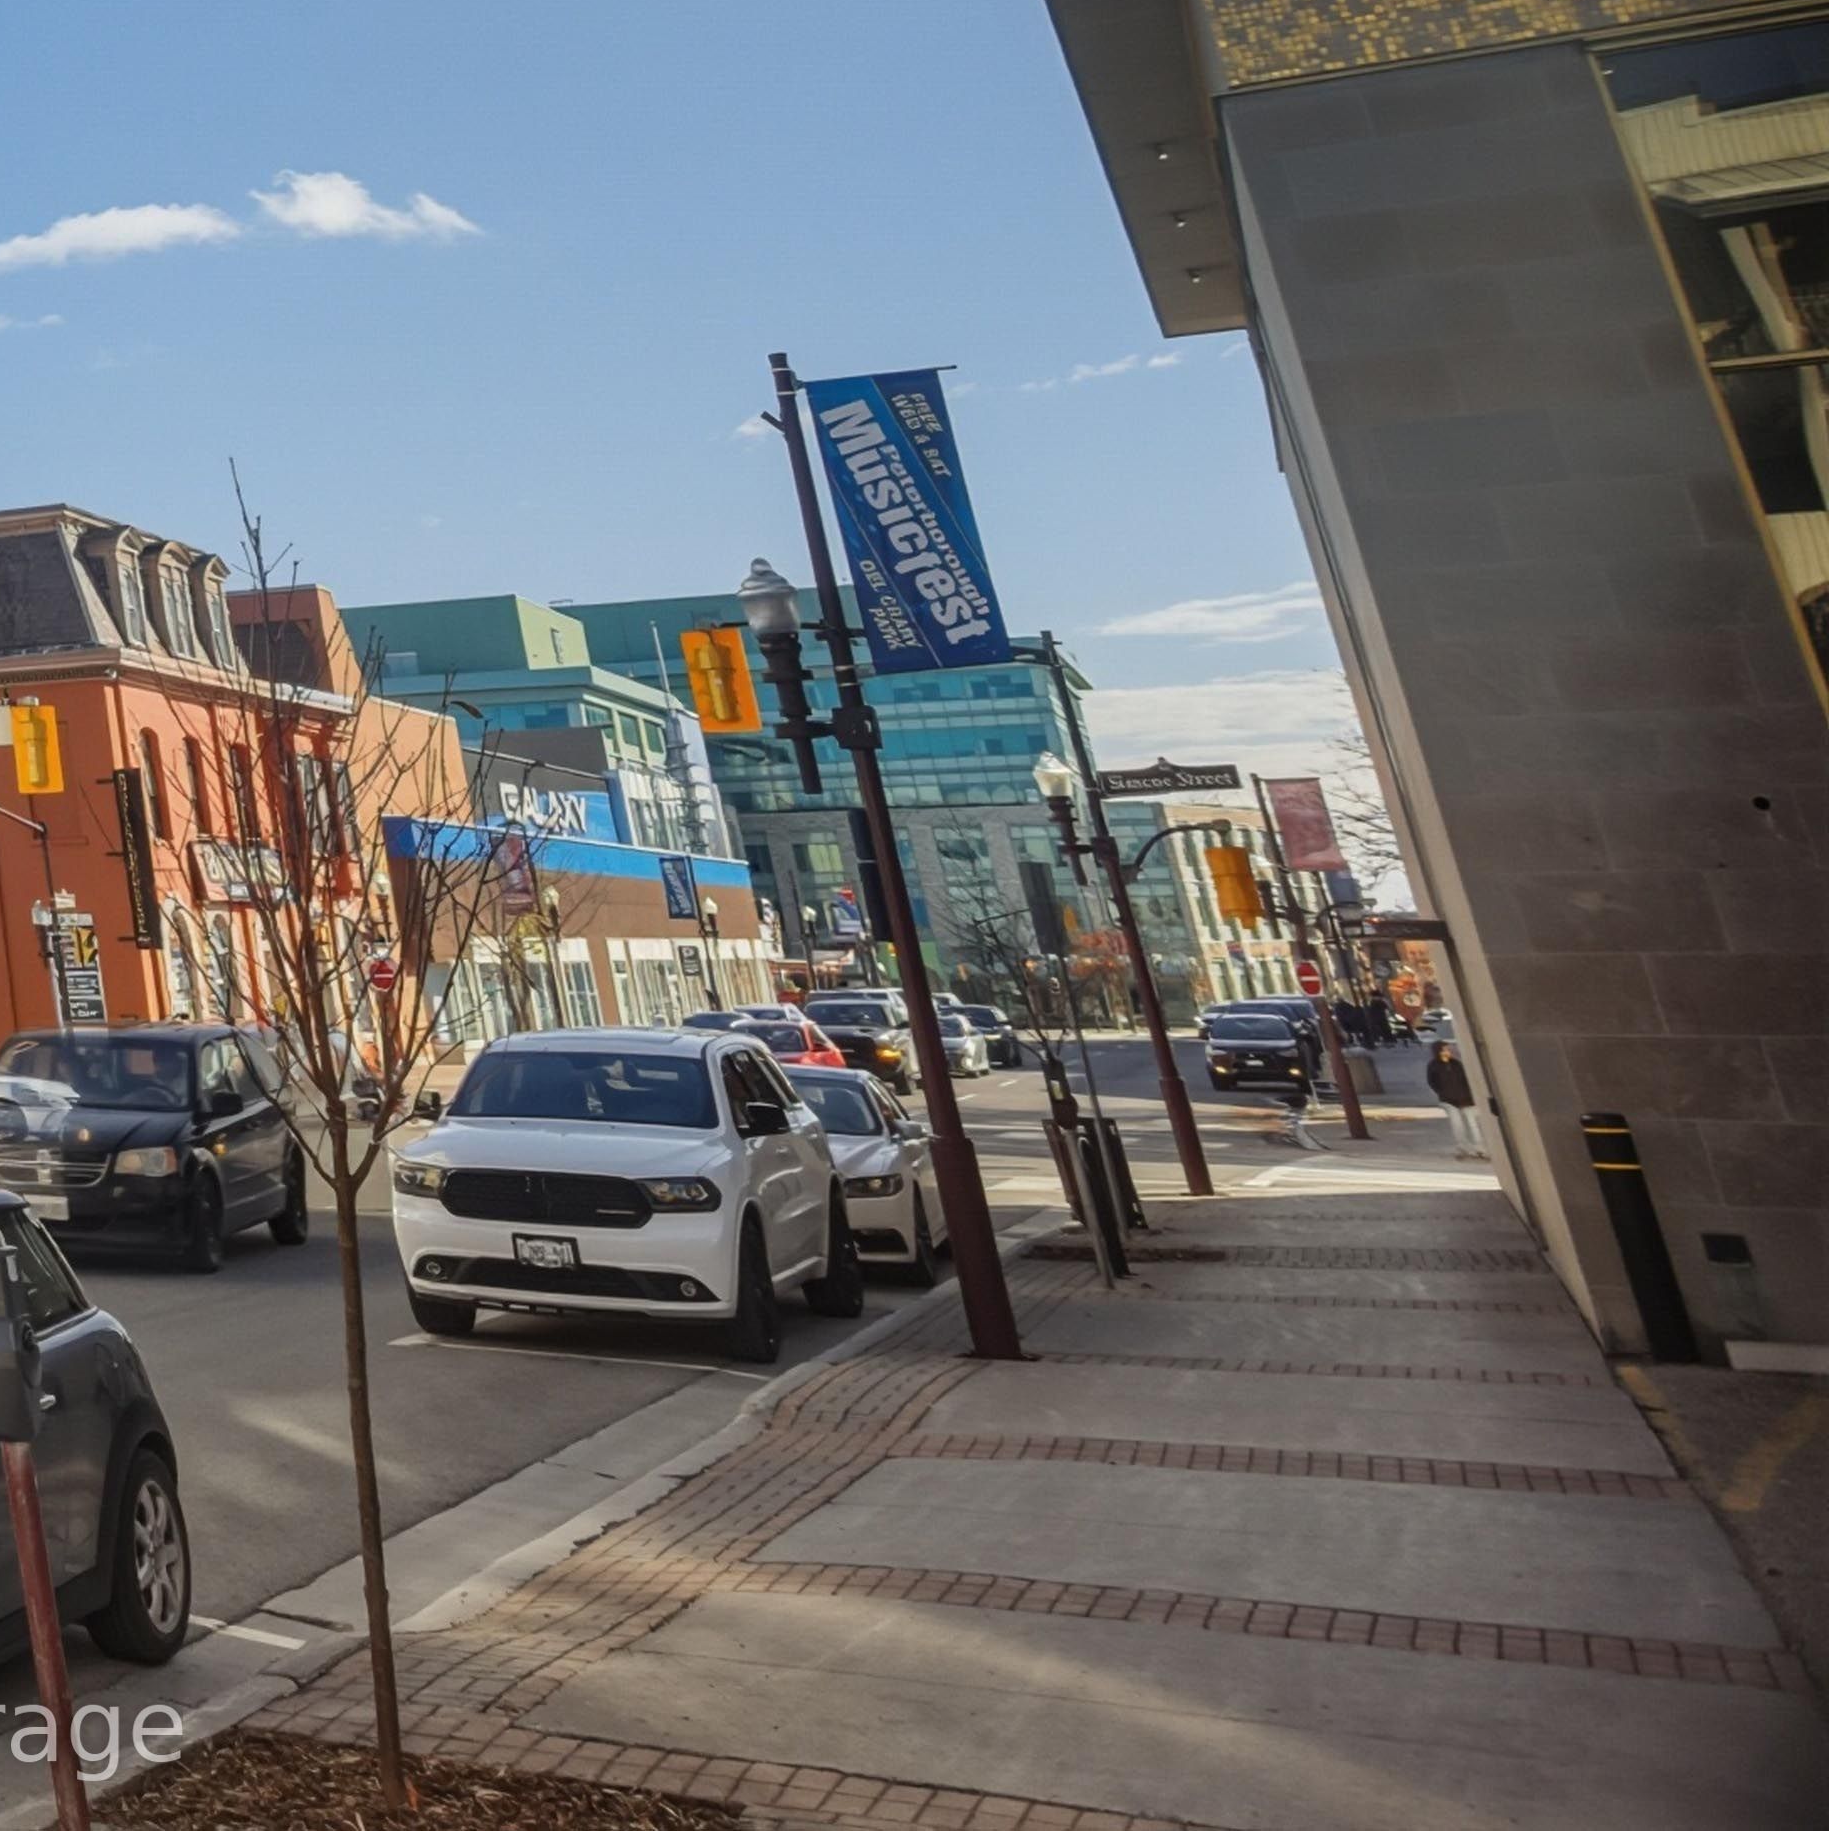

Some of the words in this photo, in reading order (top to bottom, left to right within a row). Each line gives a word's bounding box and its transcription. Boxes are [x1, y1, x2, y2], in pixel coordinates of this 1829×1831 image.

[819, 398, 992, 646] Musicfest
[879, 444, 990, 616] Peterborough
[499, 781, 587, 834] GALAXY
[1175, 771, 1234, 788] Street
